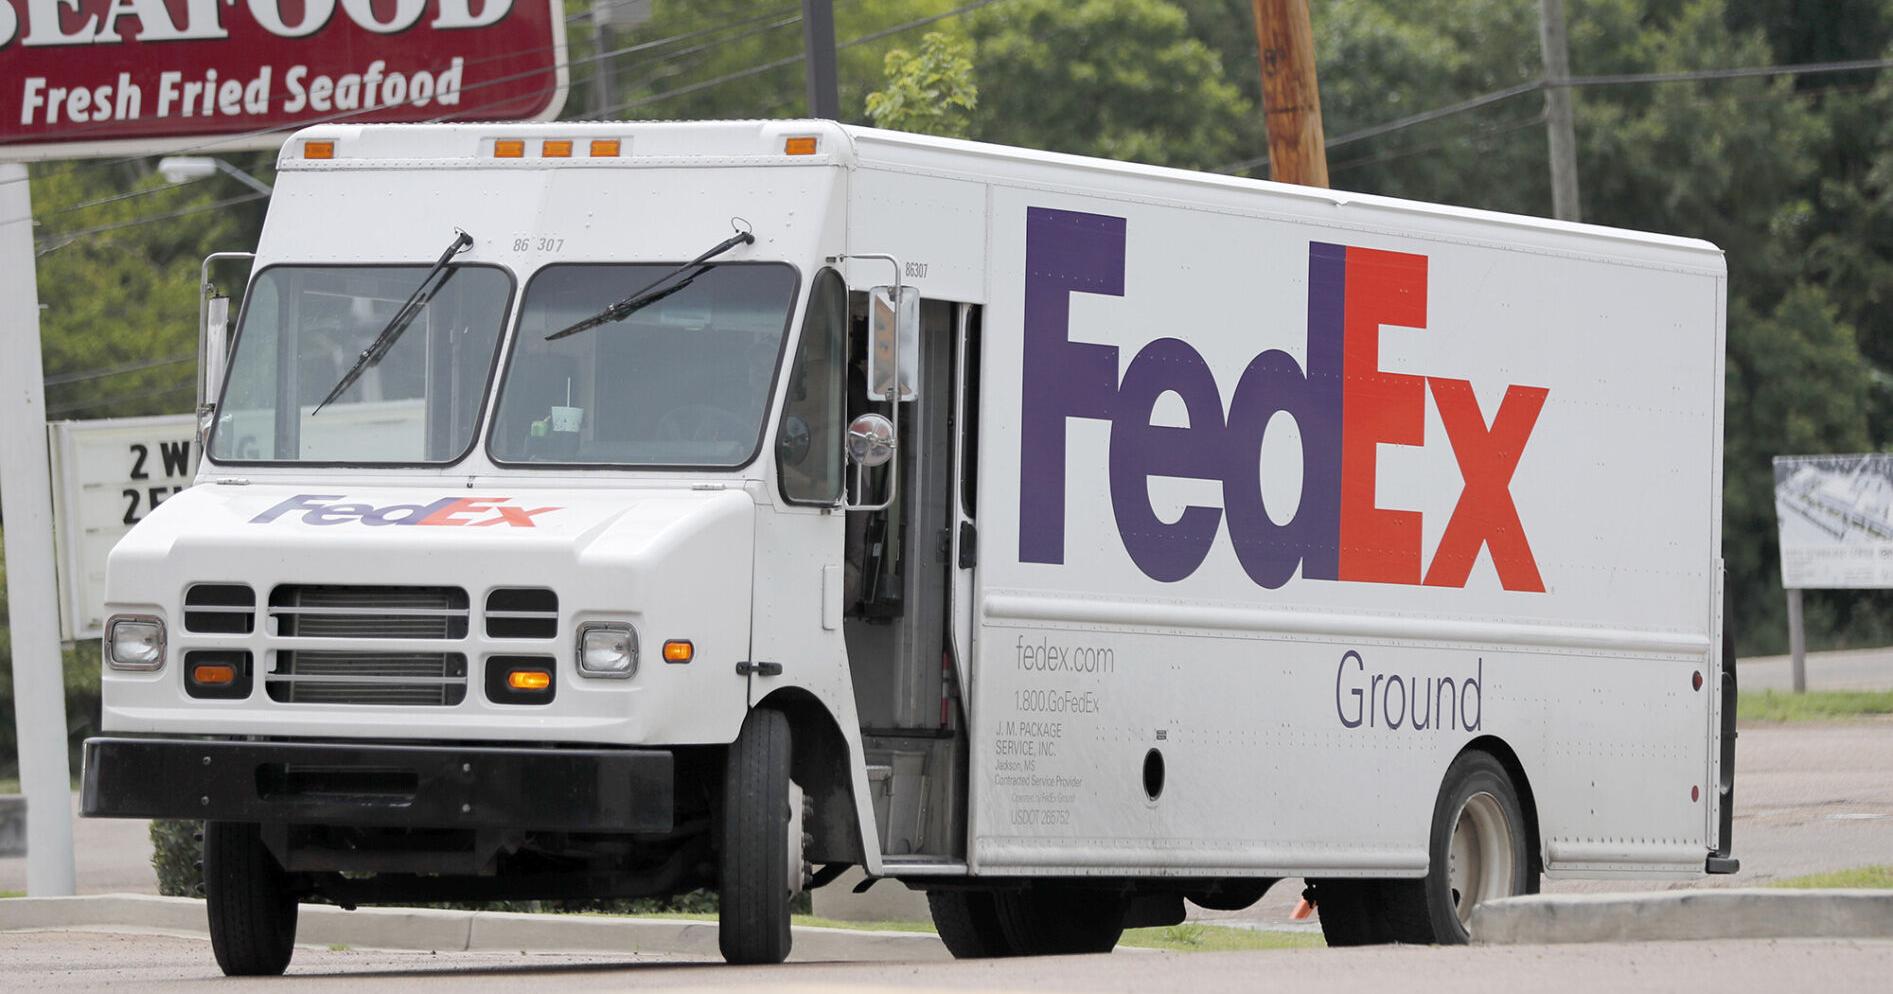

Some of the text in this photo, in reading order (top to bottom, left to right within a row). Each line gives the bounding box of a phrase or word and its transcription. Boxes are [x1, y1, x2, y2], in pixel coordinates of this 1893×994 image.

[0, 0, 514, 47] EAFOO
[21, 57, 465, 126] Fresh Fried Seafood
[513, 238, 564, 252] 86 307
[905, 261, 928, 279] 86307
[1019, 206, 1550, 594] FedEx
[130, 443, 149, 480] 2
[248, 494, 566, 528] FedEx
[1016, 635, 1114, 673] fedex.com
[1015, 689, 1100, 714] 1.800.GoFedEx
[1336, 650, 1482, 732] Ground
[995, 721, 1063, 738] J. M. PACKAGE
[1039, 741, 1057, 758] INC.
[1024, 759, 1036, 772] MS
[1031, 774, 1055, 787] Service
[1056, 775, 1082, 787] Provider
